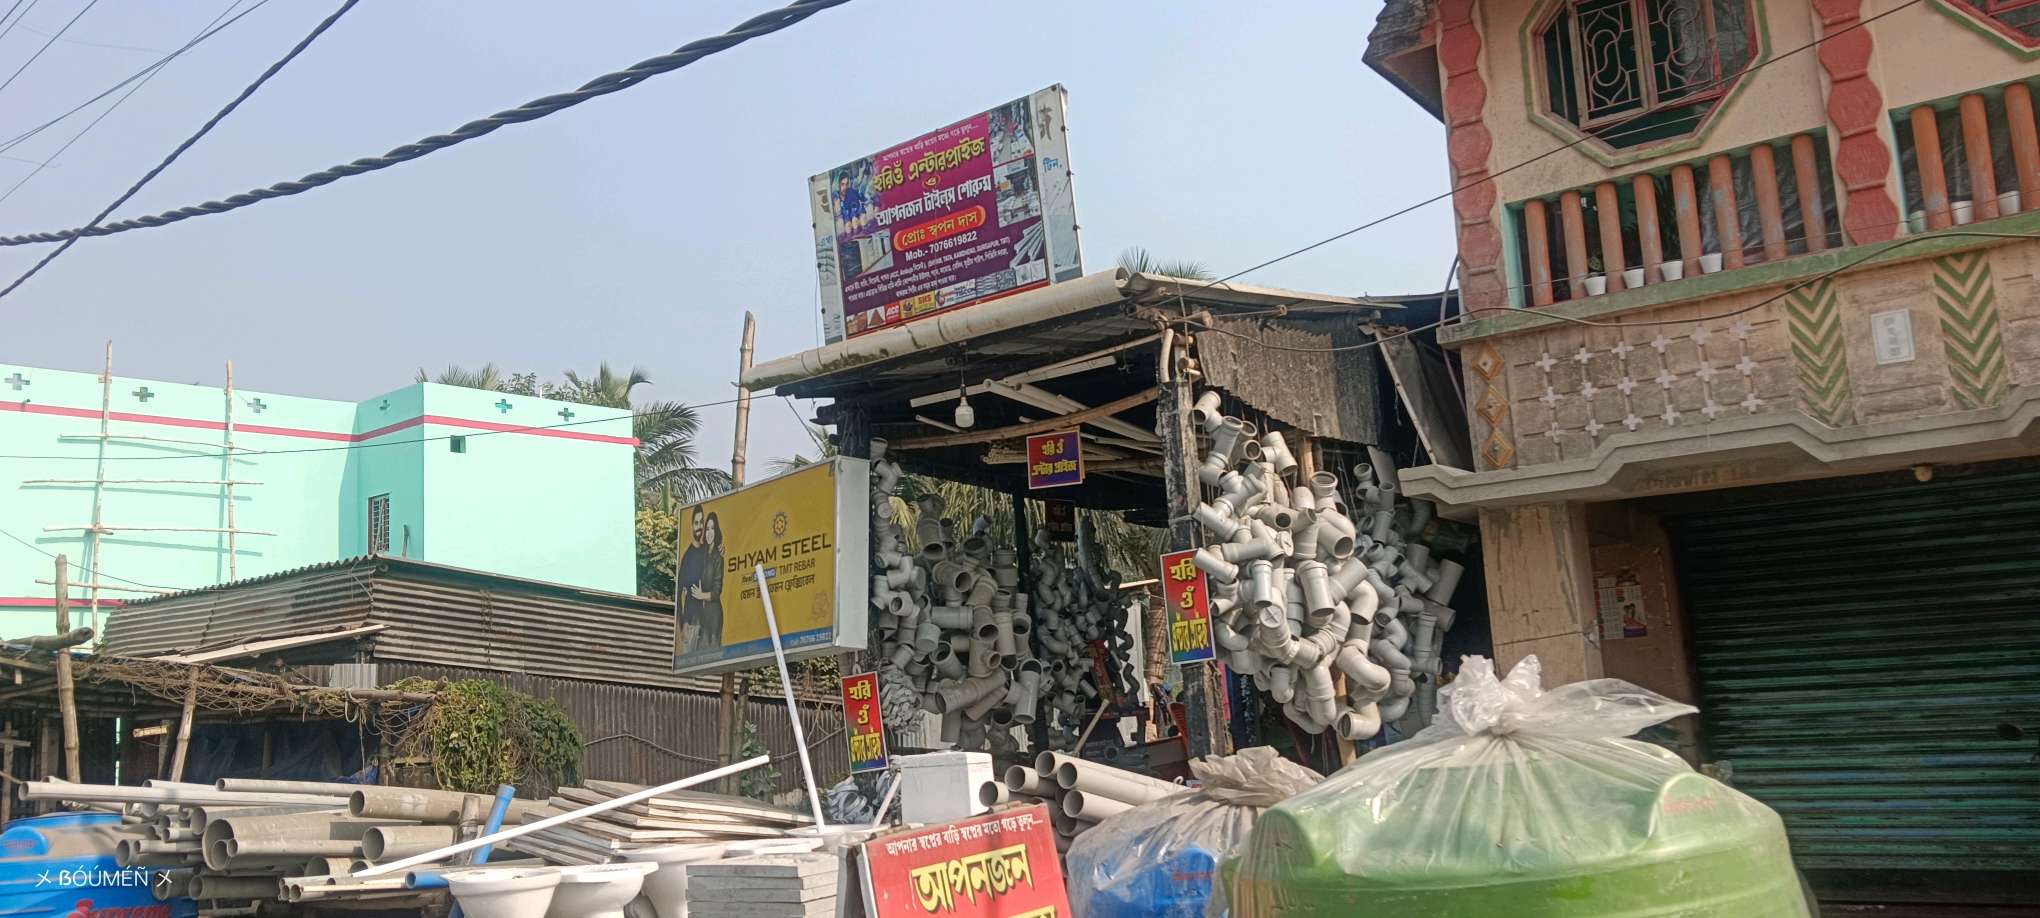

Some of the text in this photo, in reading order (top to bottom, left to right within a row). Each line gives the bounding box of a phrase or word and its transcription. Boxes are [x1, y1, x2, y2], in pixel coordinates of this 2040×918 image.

[908, 137, 986, 180] এন্টারপ্রাইজ
[876, 199, 922, 227] আপনজন
[958, 175, 992, 201] শোরুম
[928, 219, 954, 236] স্বপন
[958, 211, 978, 227] দাস
[929, 231, 978, 253] 7076619822
[728, 533, 831, 573] SHYAM STEEL
[780, 564, 793, 576] TMT
[794, 558, 816, 572] REBAR
[1169, 557, 1197, 581] হরি
[848, 679, 872, 700] হরি
[885, 838, 918, 857] আপনার
[917, 833, 942, 850] স্বপ্নের
[941, 825, 960, 845] বাড়ি
[960, 825, 983, 841] স্বপ্নের
[1001, 817, 1017, 832] গড়ে
[910, 843, 1034, 914] আপনজন
